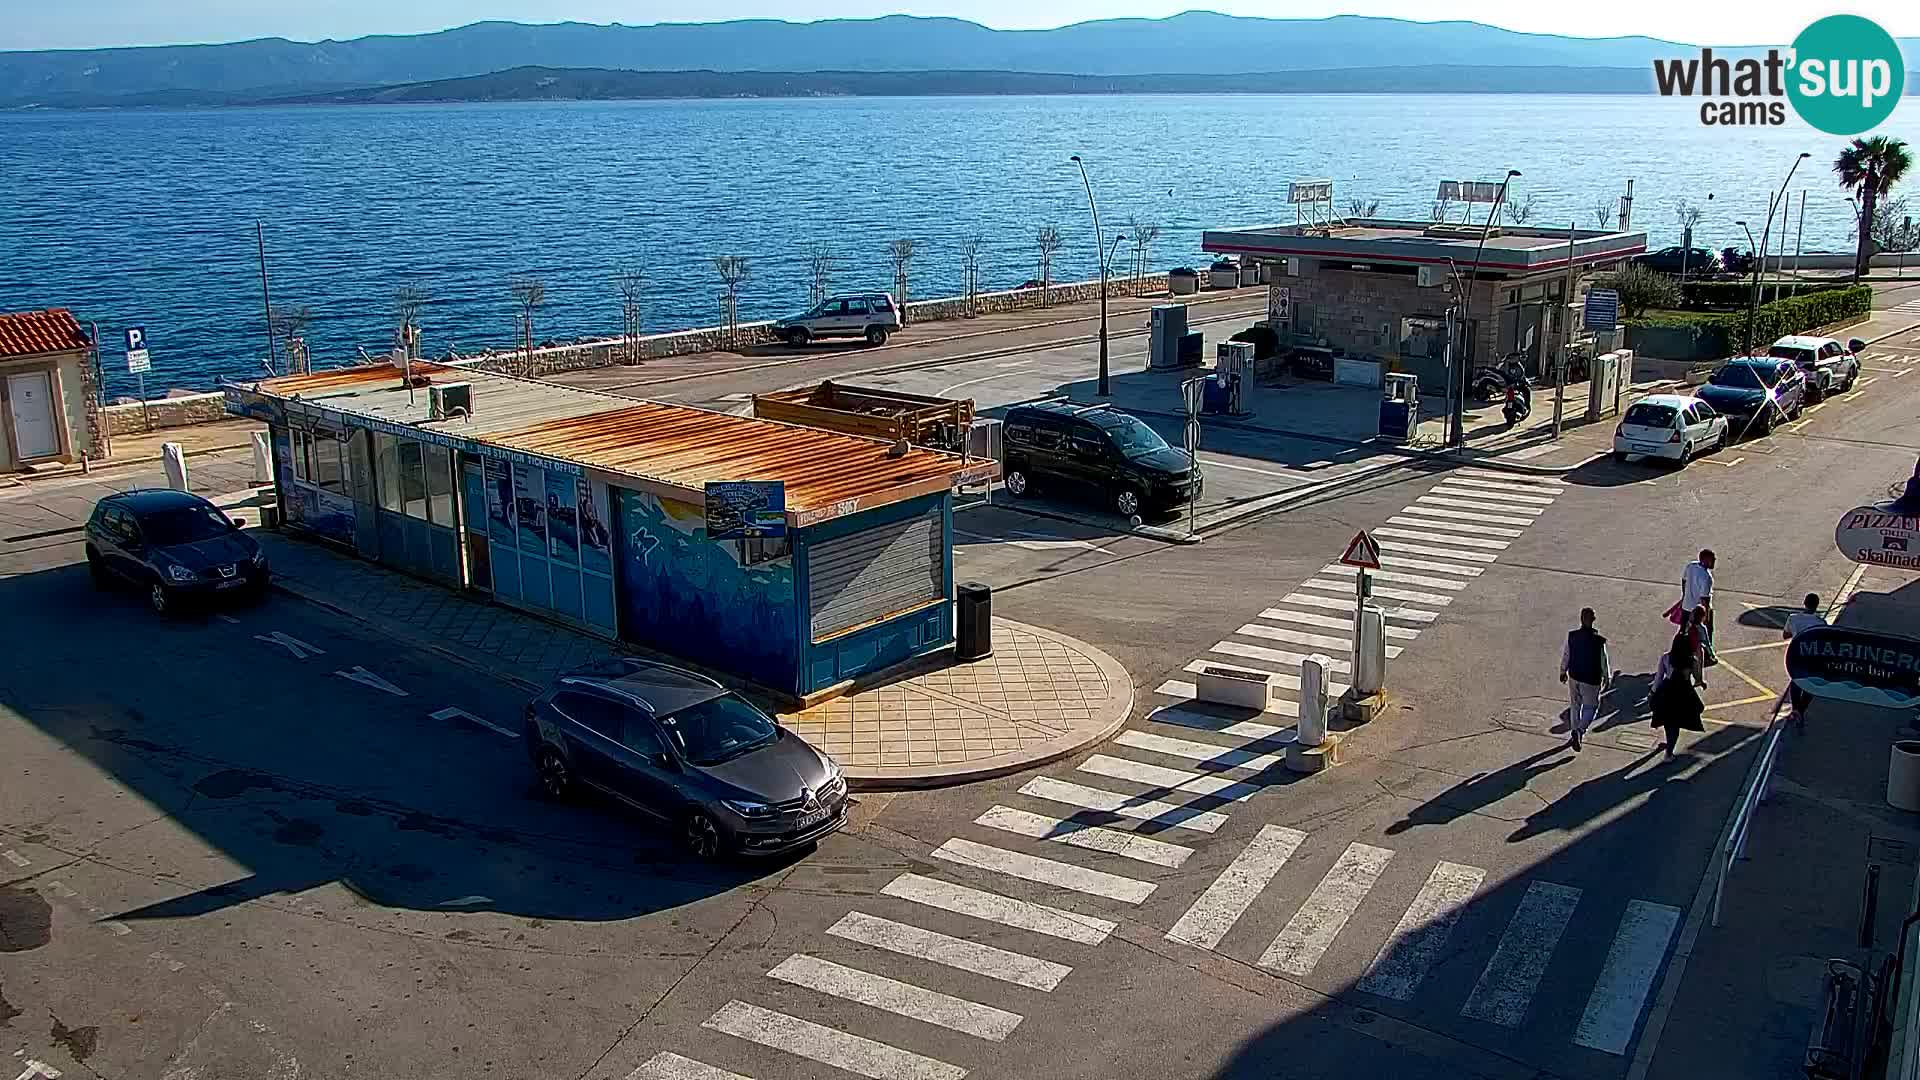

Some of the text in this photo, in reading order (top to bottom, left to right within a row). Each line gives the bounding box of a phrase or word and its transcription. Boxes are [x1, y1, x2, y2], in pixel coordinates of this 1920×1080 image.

[128, 329, 142, 349] P
[493, 448, 525, 463] STATION
[527, 455, 553, 469] TICKET
[554, 462, 581, 475] OFFICE
[1868, 664, 1895, 679] bar
